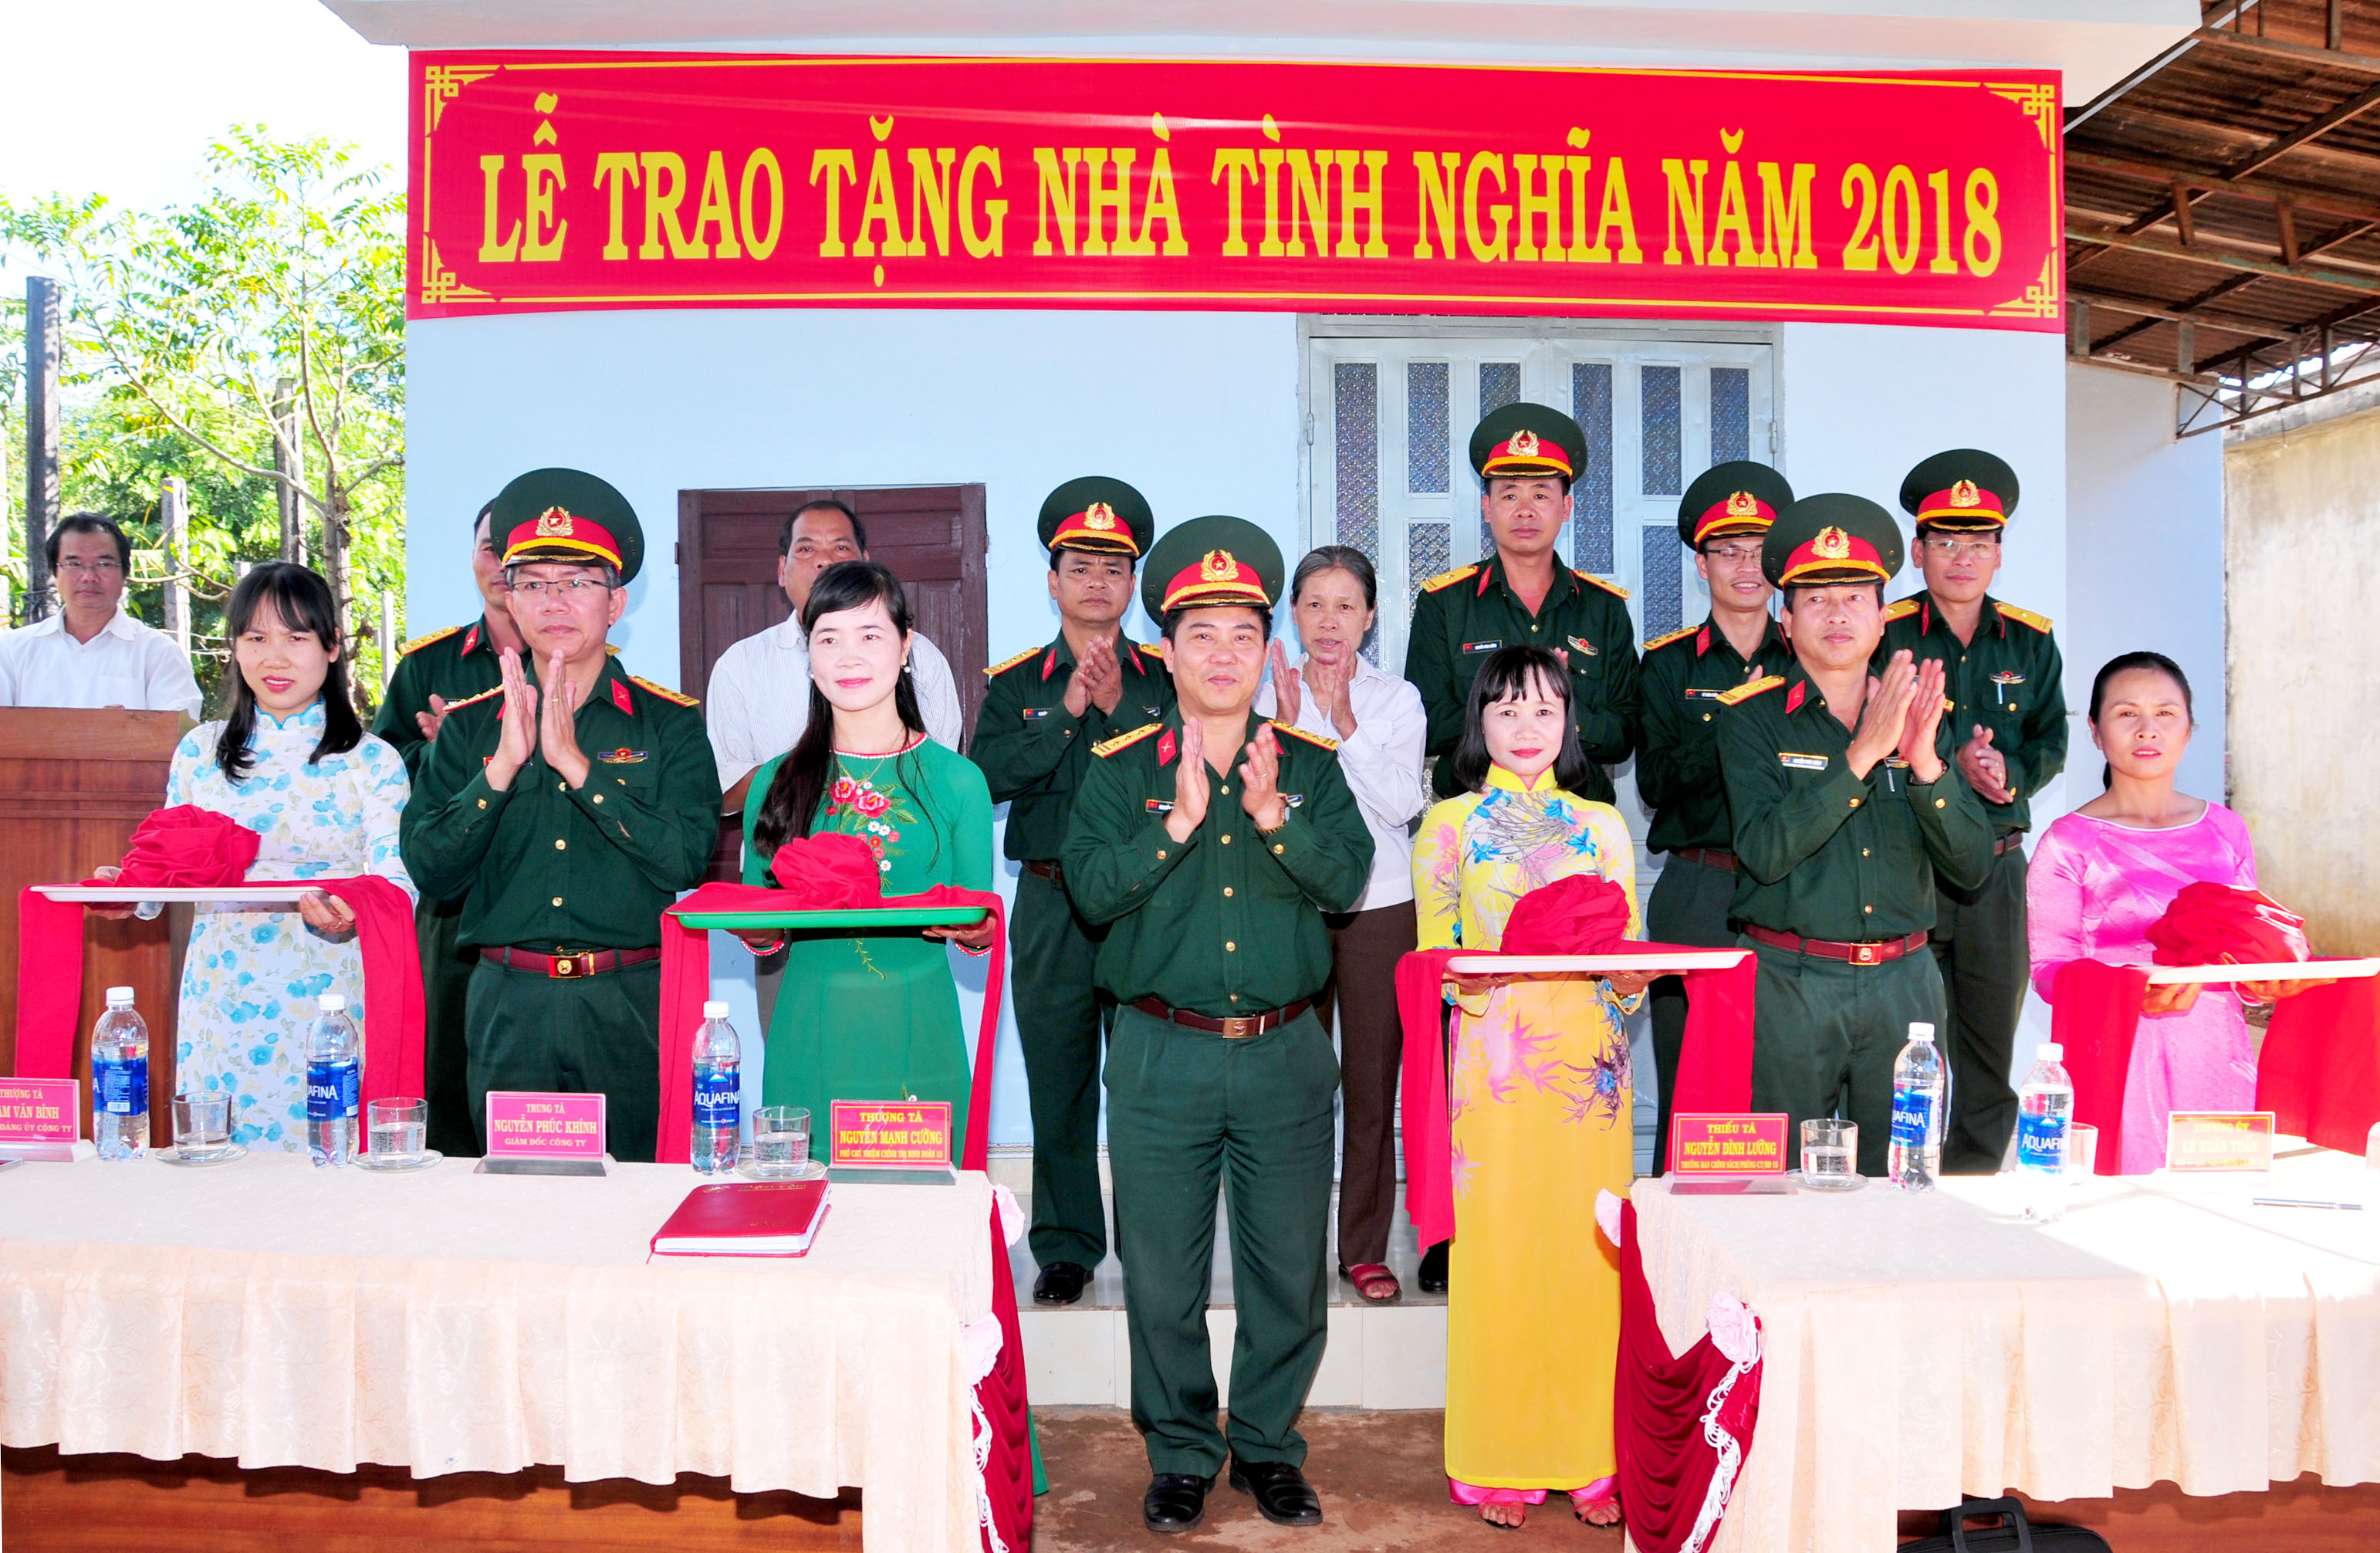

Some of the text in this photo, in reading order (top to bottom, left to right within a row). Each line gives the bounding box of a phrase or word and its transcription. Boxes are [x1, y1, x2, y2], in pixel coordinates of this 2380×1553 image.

[480, 93, 2001, 286] LỄ TRAO TẶNG NHÀ TÌNH NGHĨA NĂM 2018
[32, 1087, 43, 1099] TÁ
[12, 1102, 33, 1118] VĂN
[35, 1103, 59, 1119] BÌNH
[526, 1102, 565, 1114] TRUNG TÁ
[494, 1114, 533, 1132] NGUYỄN
[536, 1117, 563, 1133] PHÚC
[860, 1110, 923, 1124] THƯỢNG TÁ
[1707, 1121, 1756, 1133] THIẾU TÁ
[505, 1137, 527, 1145] GIÁM
[549, 1138, 573, 1147] CÔNG
[840, 1123, 878, 1144] NGUYỄN
[880, 1130, 908, 1147] MẠNH
[1684, 1135, 1720, 1155] NGUYỄN
[1722, 1139, 1745, 1155] ĐÌNH
